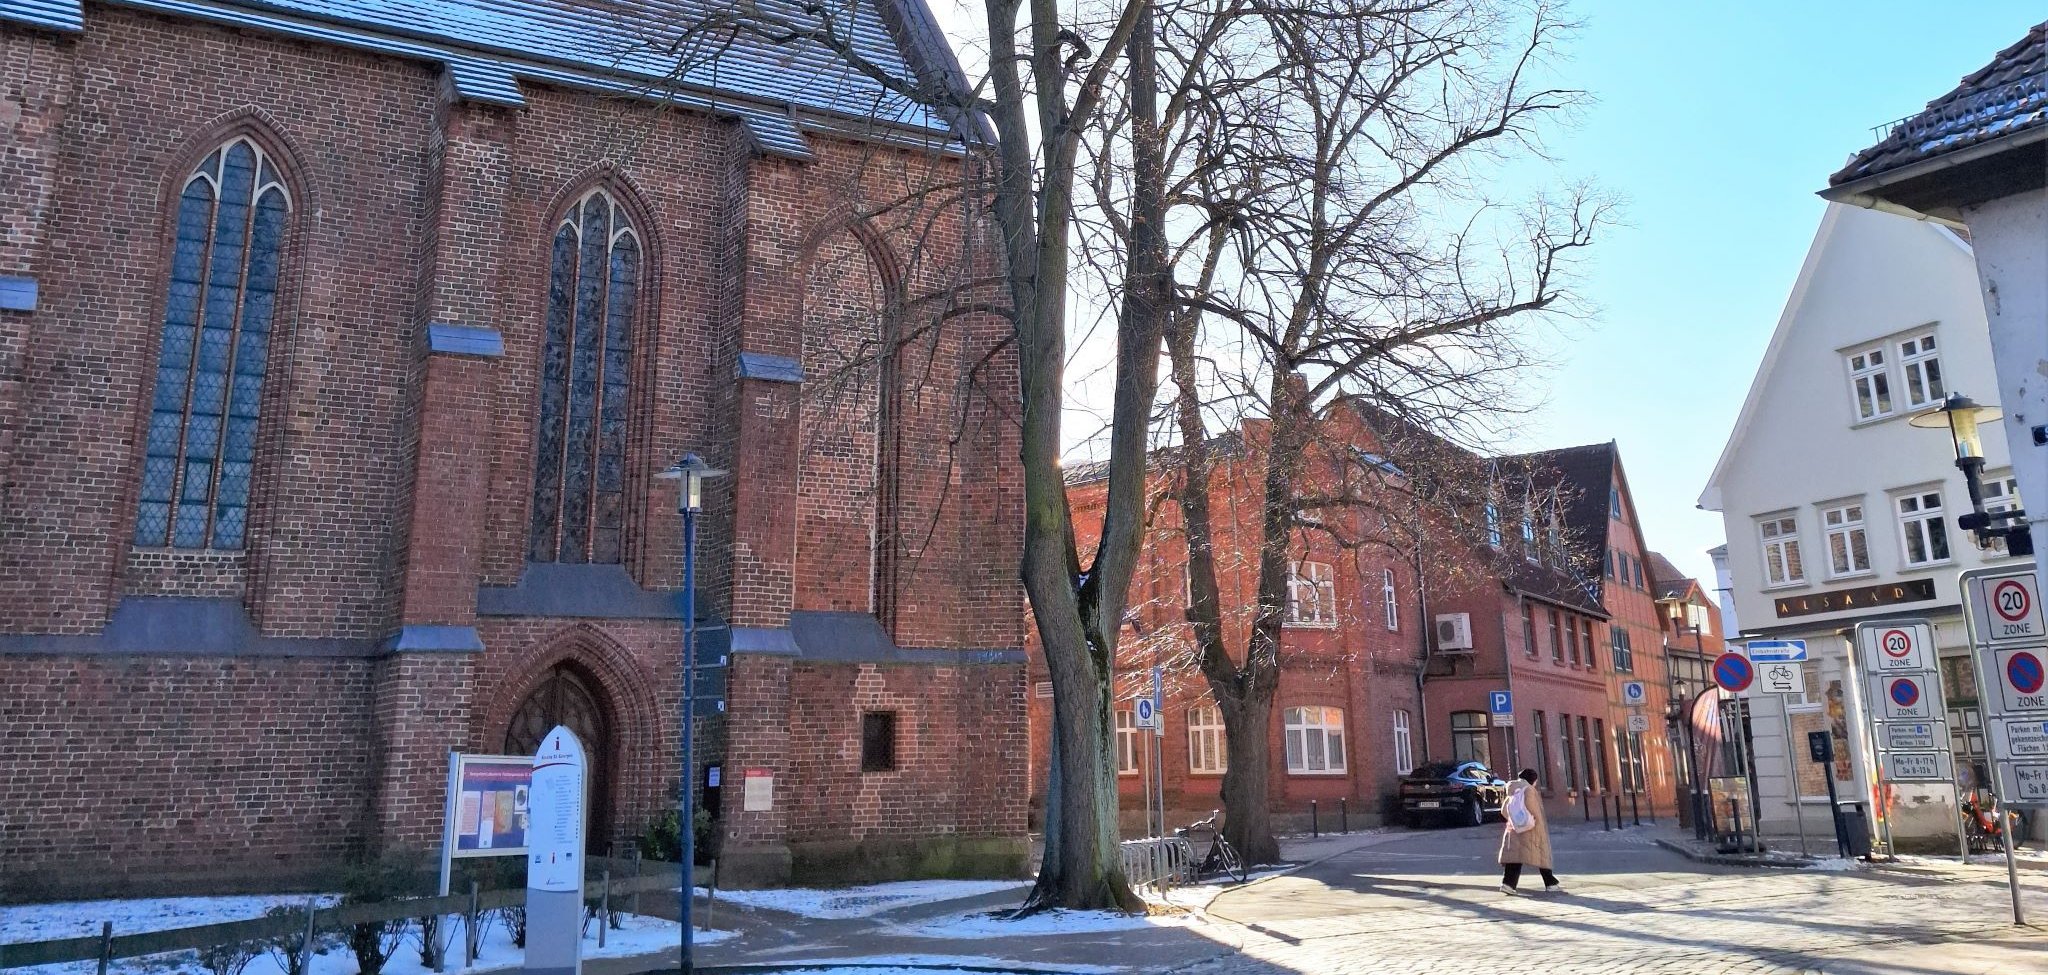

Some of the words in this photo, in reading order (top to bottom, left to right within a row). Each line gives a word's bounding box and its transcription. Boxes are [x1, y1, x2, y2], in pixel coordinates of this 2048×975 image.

[1781, 584, 1927, 613] ALSAADI
[2002, 592, 2024, 610] 20
[2004, 623, 2031, 635] ZONE
[1889, 637, 1906, 650] 20
[1495, 694, 1507, 711] P
[2016, 696, 2046, 707] ZONE
[1897, 708, 1918, 716] ZONE
[2018, 770, 2041, 780] Mo-Fr
[2029, 783, 2039, 794] Sa
